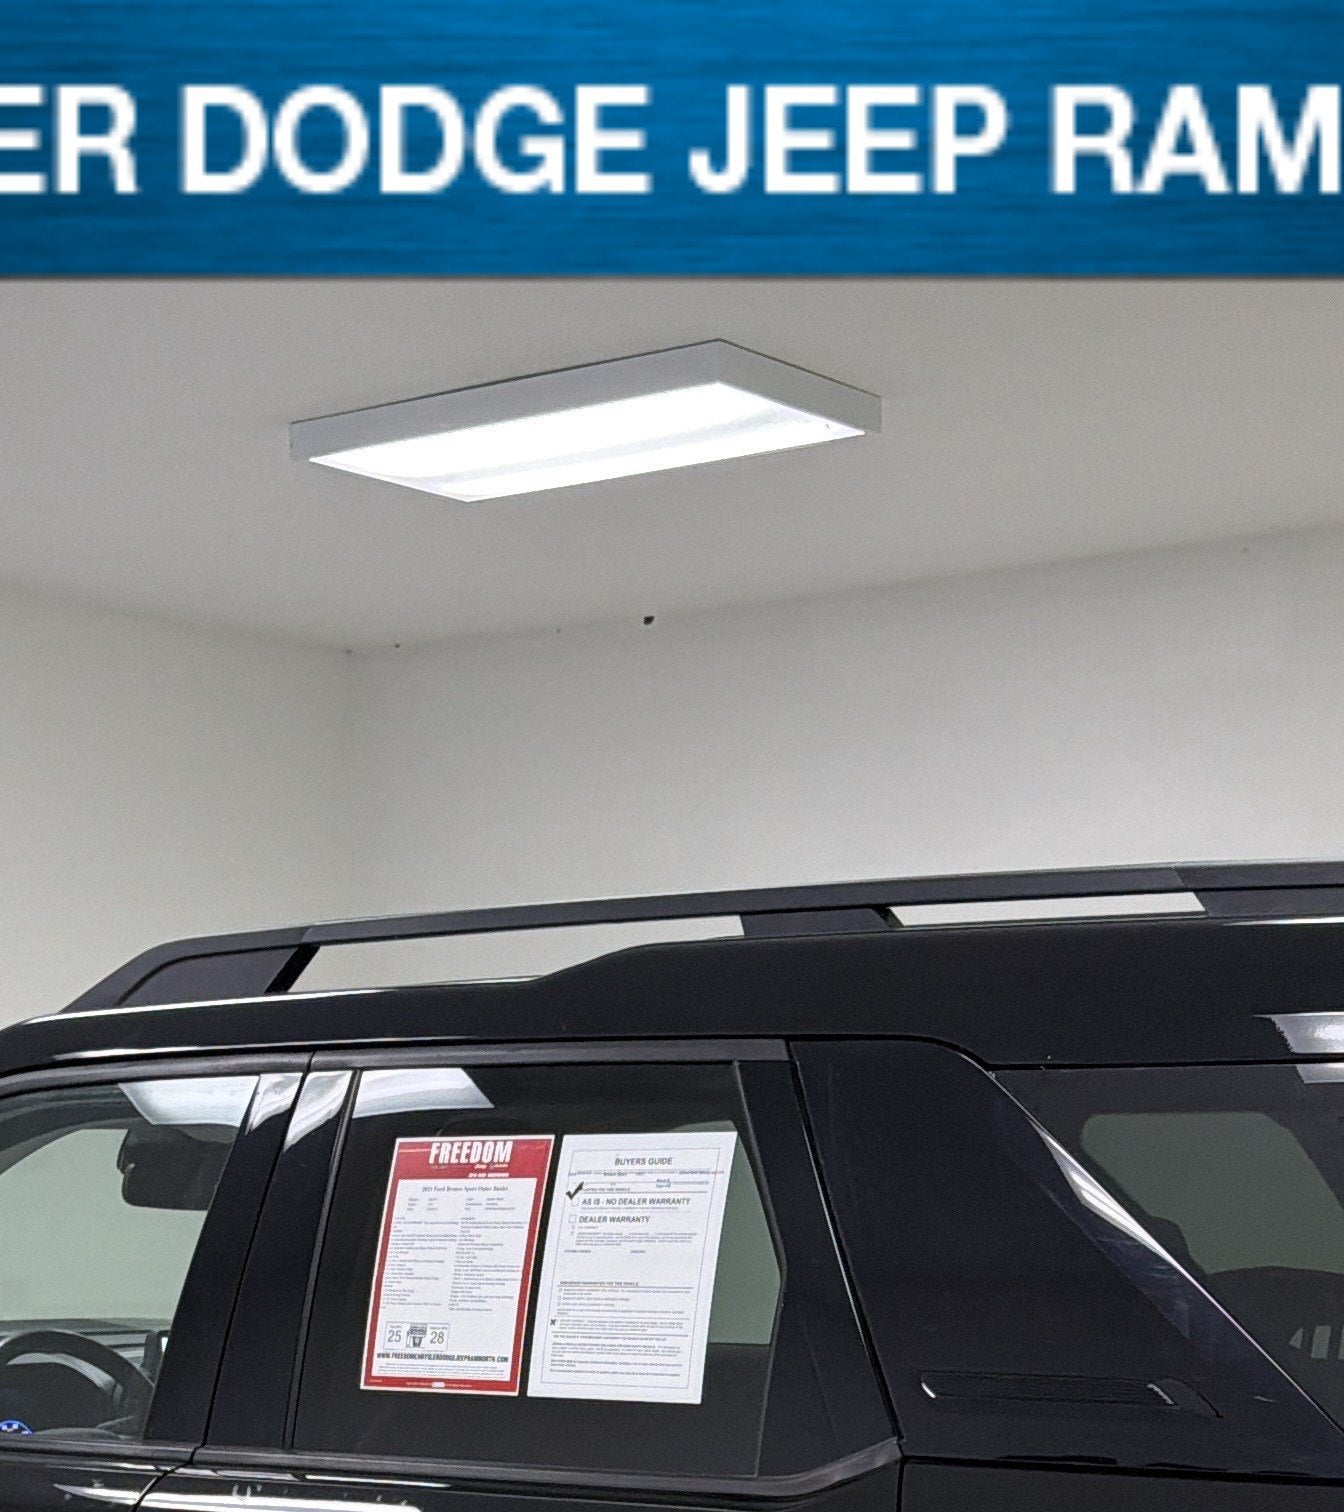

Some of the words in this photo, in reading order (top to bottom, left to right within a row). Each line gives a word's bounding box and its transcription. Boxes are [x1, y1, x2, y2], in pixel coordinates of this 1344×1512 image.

[428, 1140, 514, 1165] FREEDOM
[614, 1157, 647, 1166] BUYERS
[648, 1157, 673, 1166] GUIDE
[581, 1198, 592, 1206] AS
[592, 1198, 601, 1206] IS
[605, 1198, 617, 1206] NO
[618, 1198, 648, 1206] DEALER
[648, 1197, 691, 1206] WARRANTY
[578, 1216, 608, 1224] DEALER
[609, 1215, 651, 1224] WARRANTY
[387, 1329, 402, 1343] 25
[429, 1330, 445, 1344] 28
